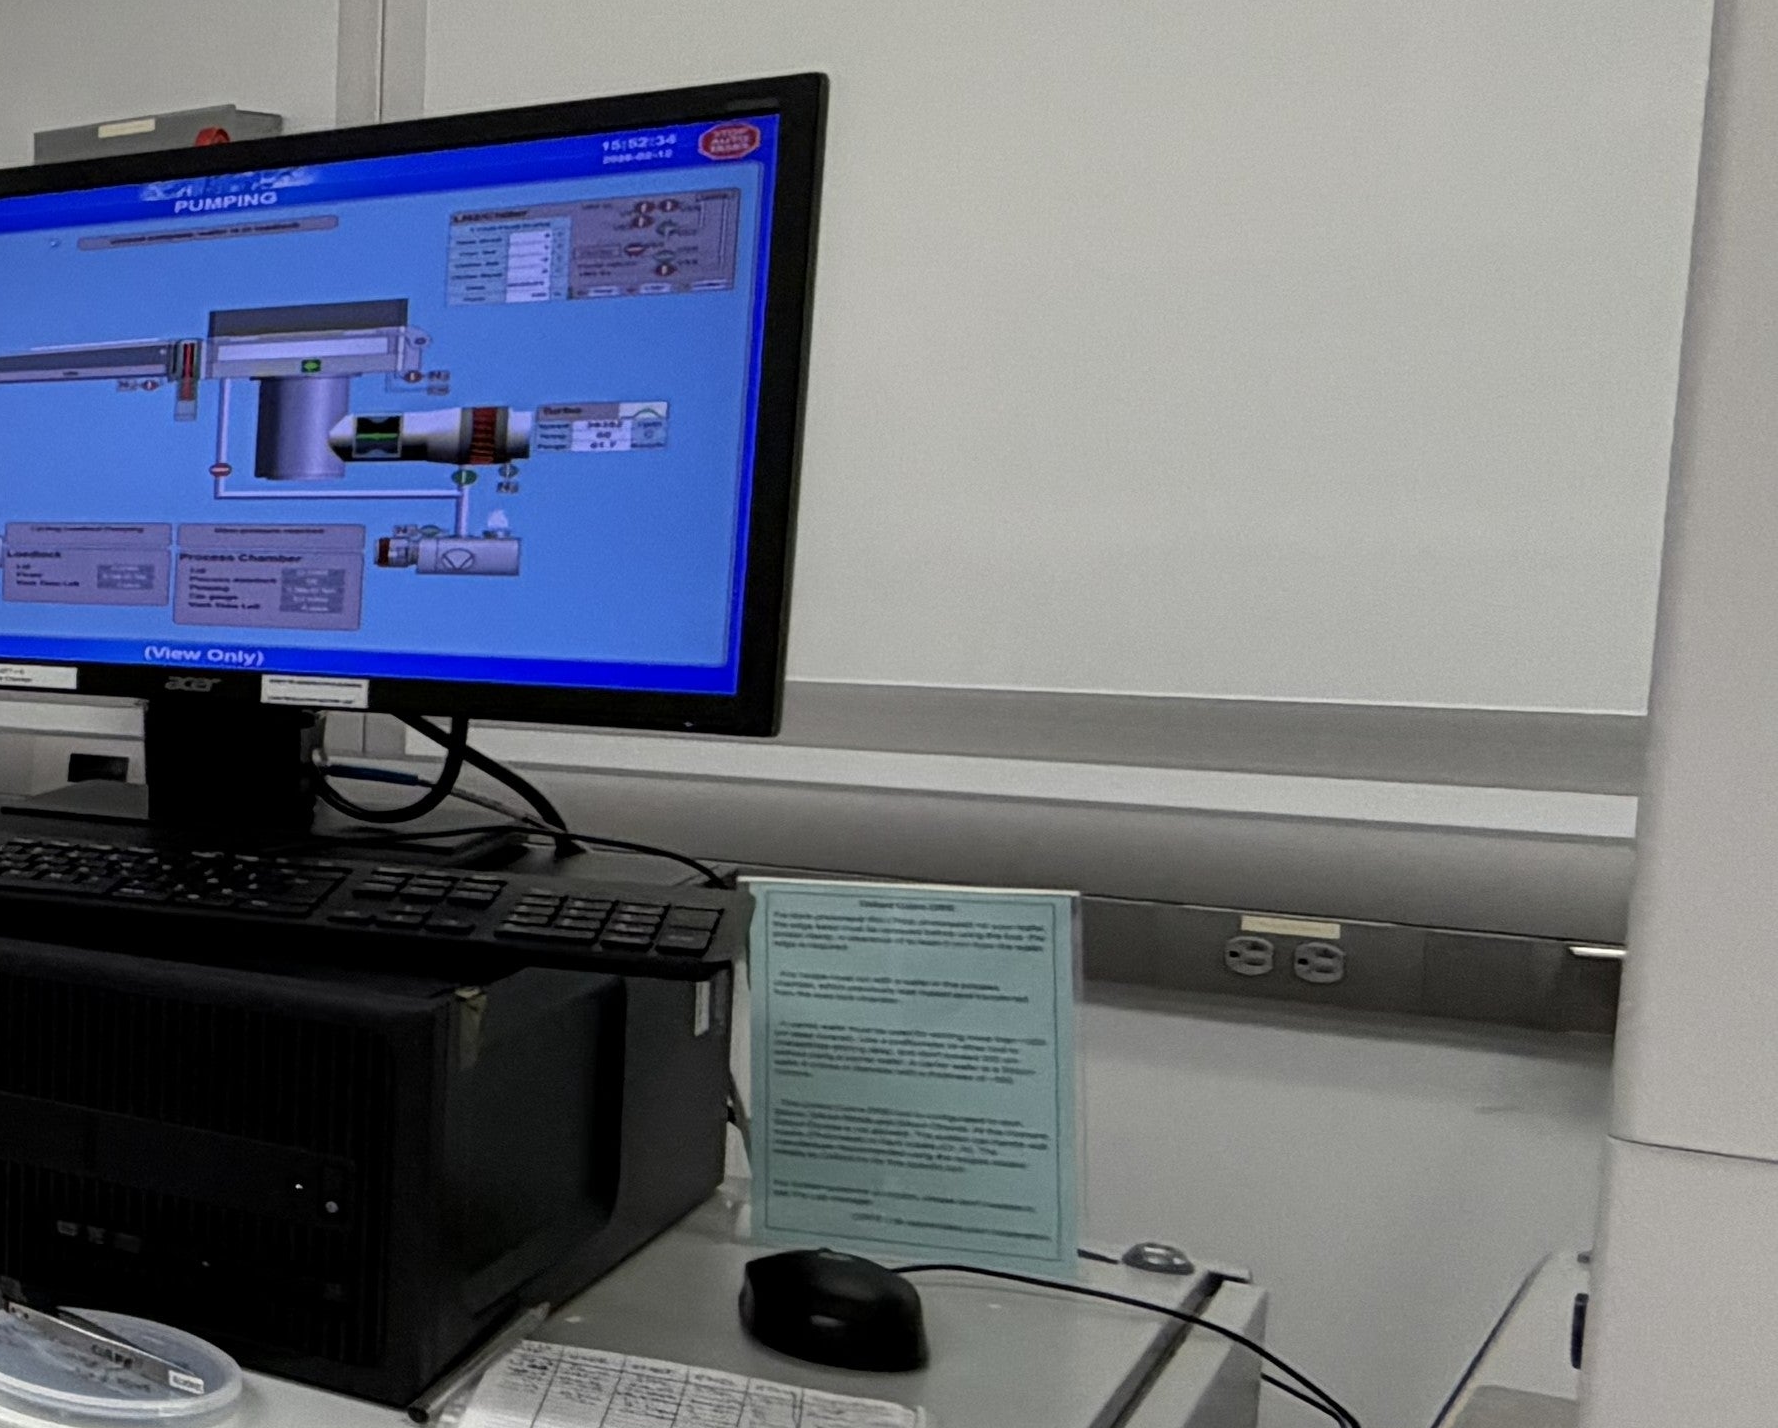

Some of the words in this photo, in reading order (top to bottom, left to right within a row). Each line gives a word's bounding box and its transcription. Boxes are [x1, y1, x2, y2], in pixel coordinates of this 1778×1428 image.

[174, 190, 277, 213] PUMPING
[143, 646, 201, 664] (View
[206, 648, 264, 668] Only)
[164, 676, 222, 692] acer
